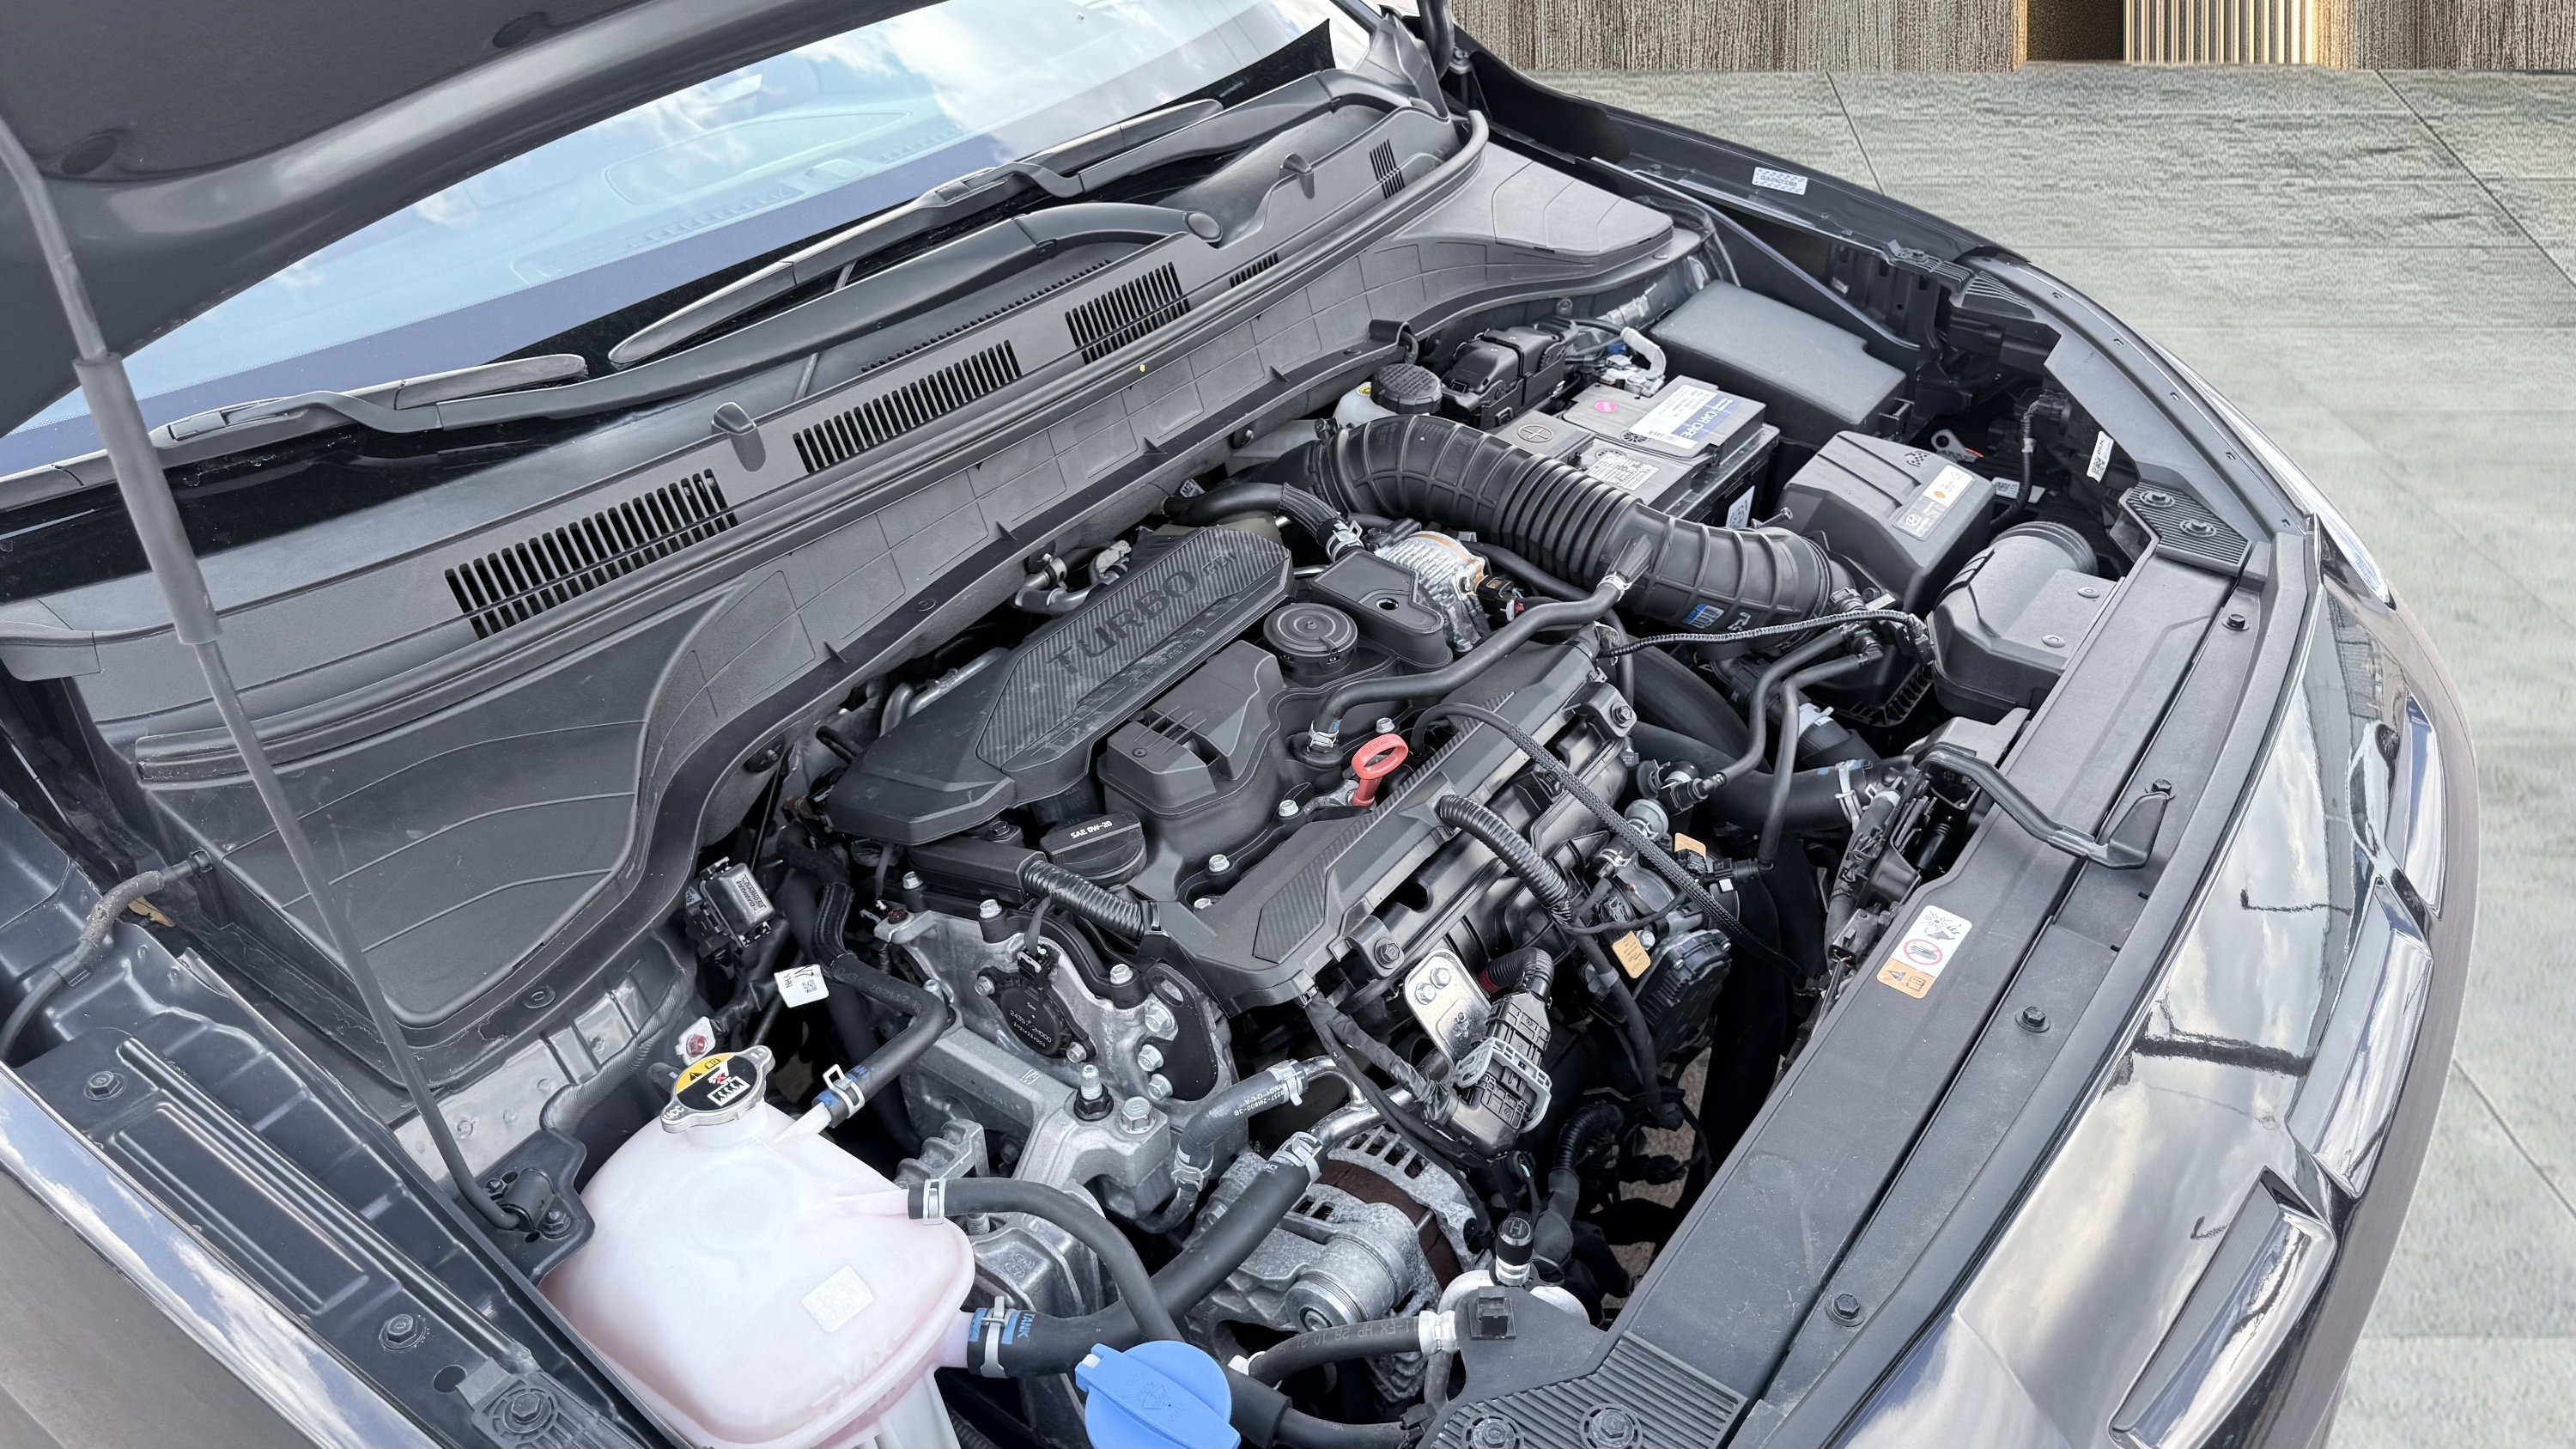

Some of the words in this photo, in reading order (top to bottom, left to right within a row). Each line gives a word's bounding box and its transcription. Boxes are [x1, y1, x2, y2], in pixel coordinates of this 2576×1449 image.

[1046, 570, 1197, 674] TURBO
[1070, 829, 1088, 839] SAE
[1086, 820, 1113, 833] 0W-20
[1018, 1313, 1036, 1338] TANK
